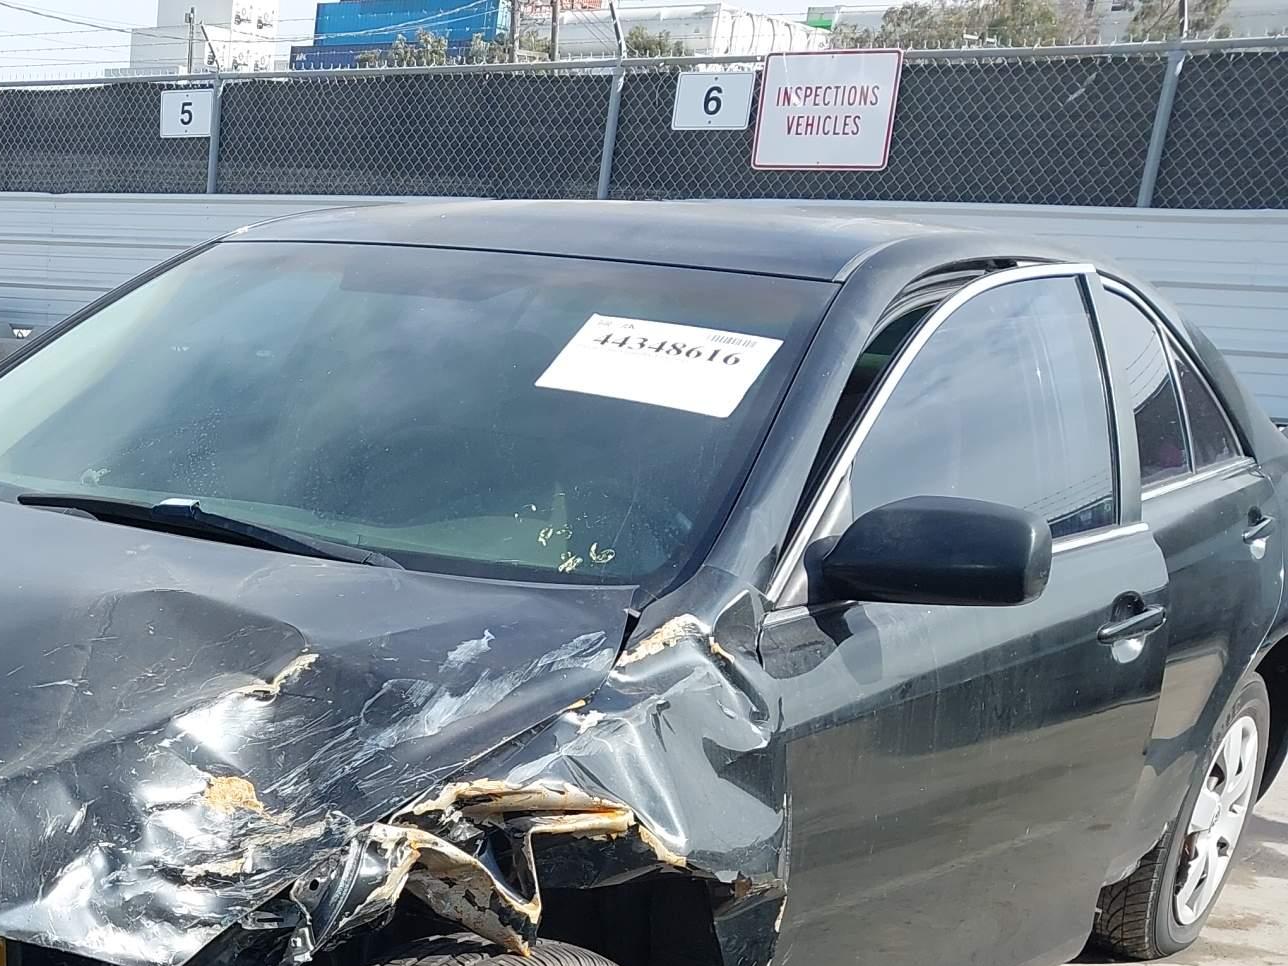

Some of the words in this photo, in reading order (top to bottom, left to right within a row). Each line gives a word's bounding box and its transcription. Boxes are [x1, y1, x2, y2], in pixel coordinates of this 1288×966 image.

[703, 85, 723, 116] 6
[775, 84, 880, 107] INSPECTIONS
[180, 101, 193, 126] 5
[786, 114, 861, 136] VEHICLES
[593, 332, 742, 367] 44348616
